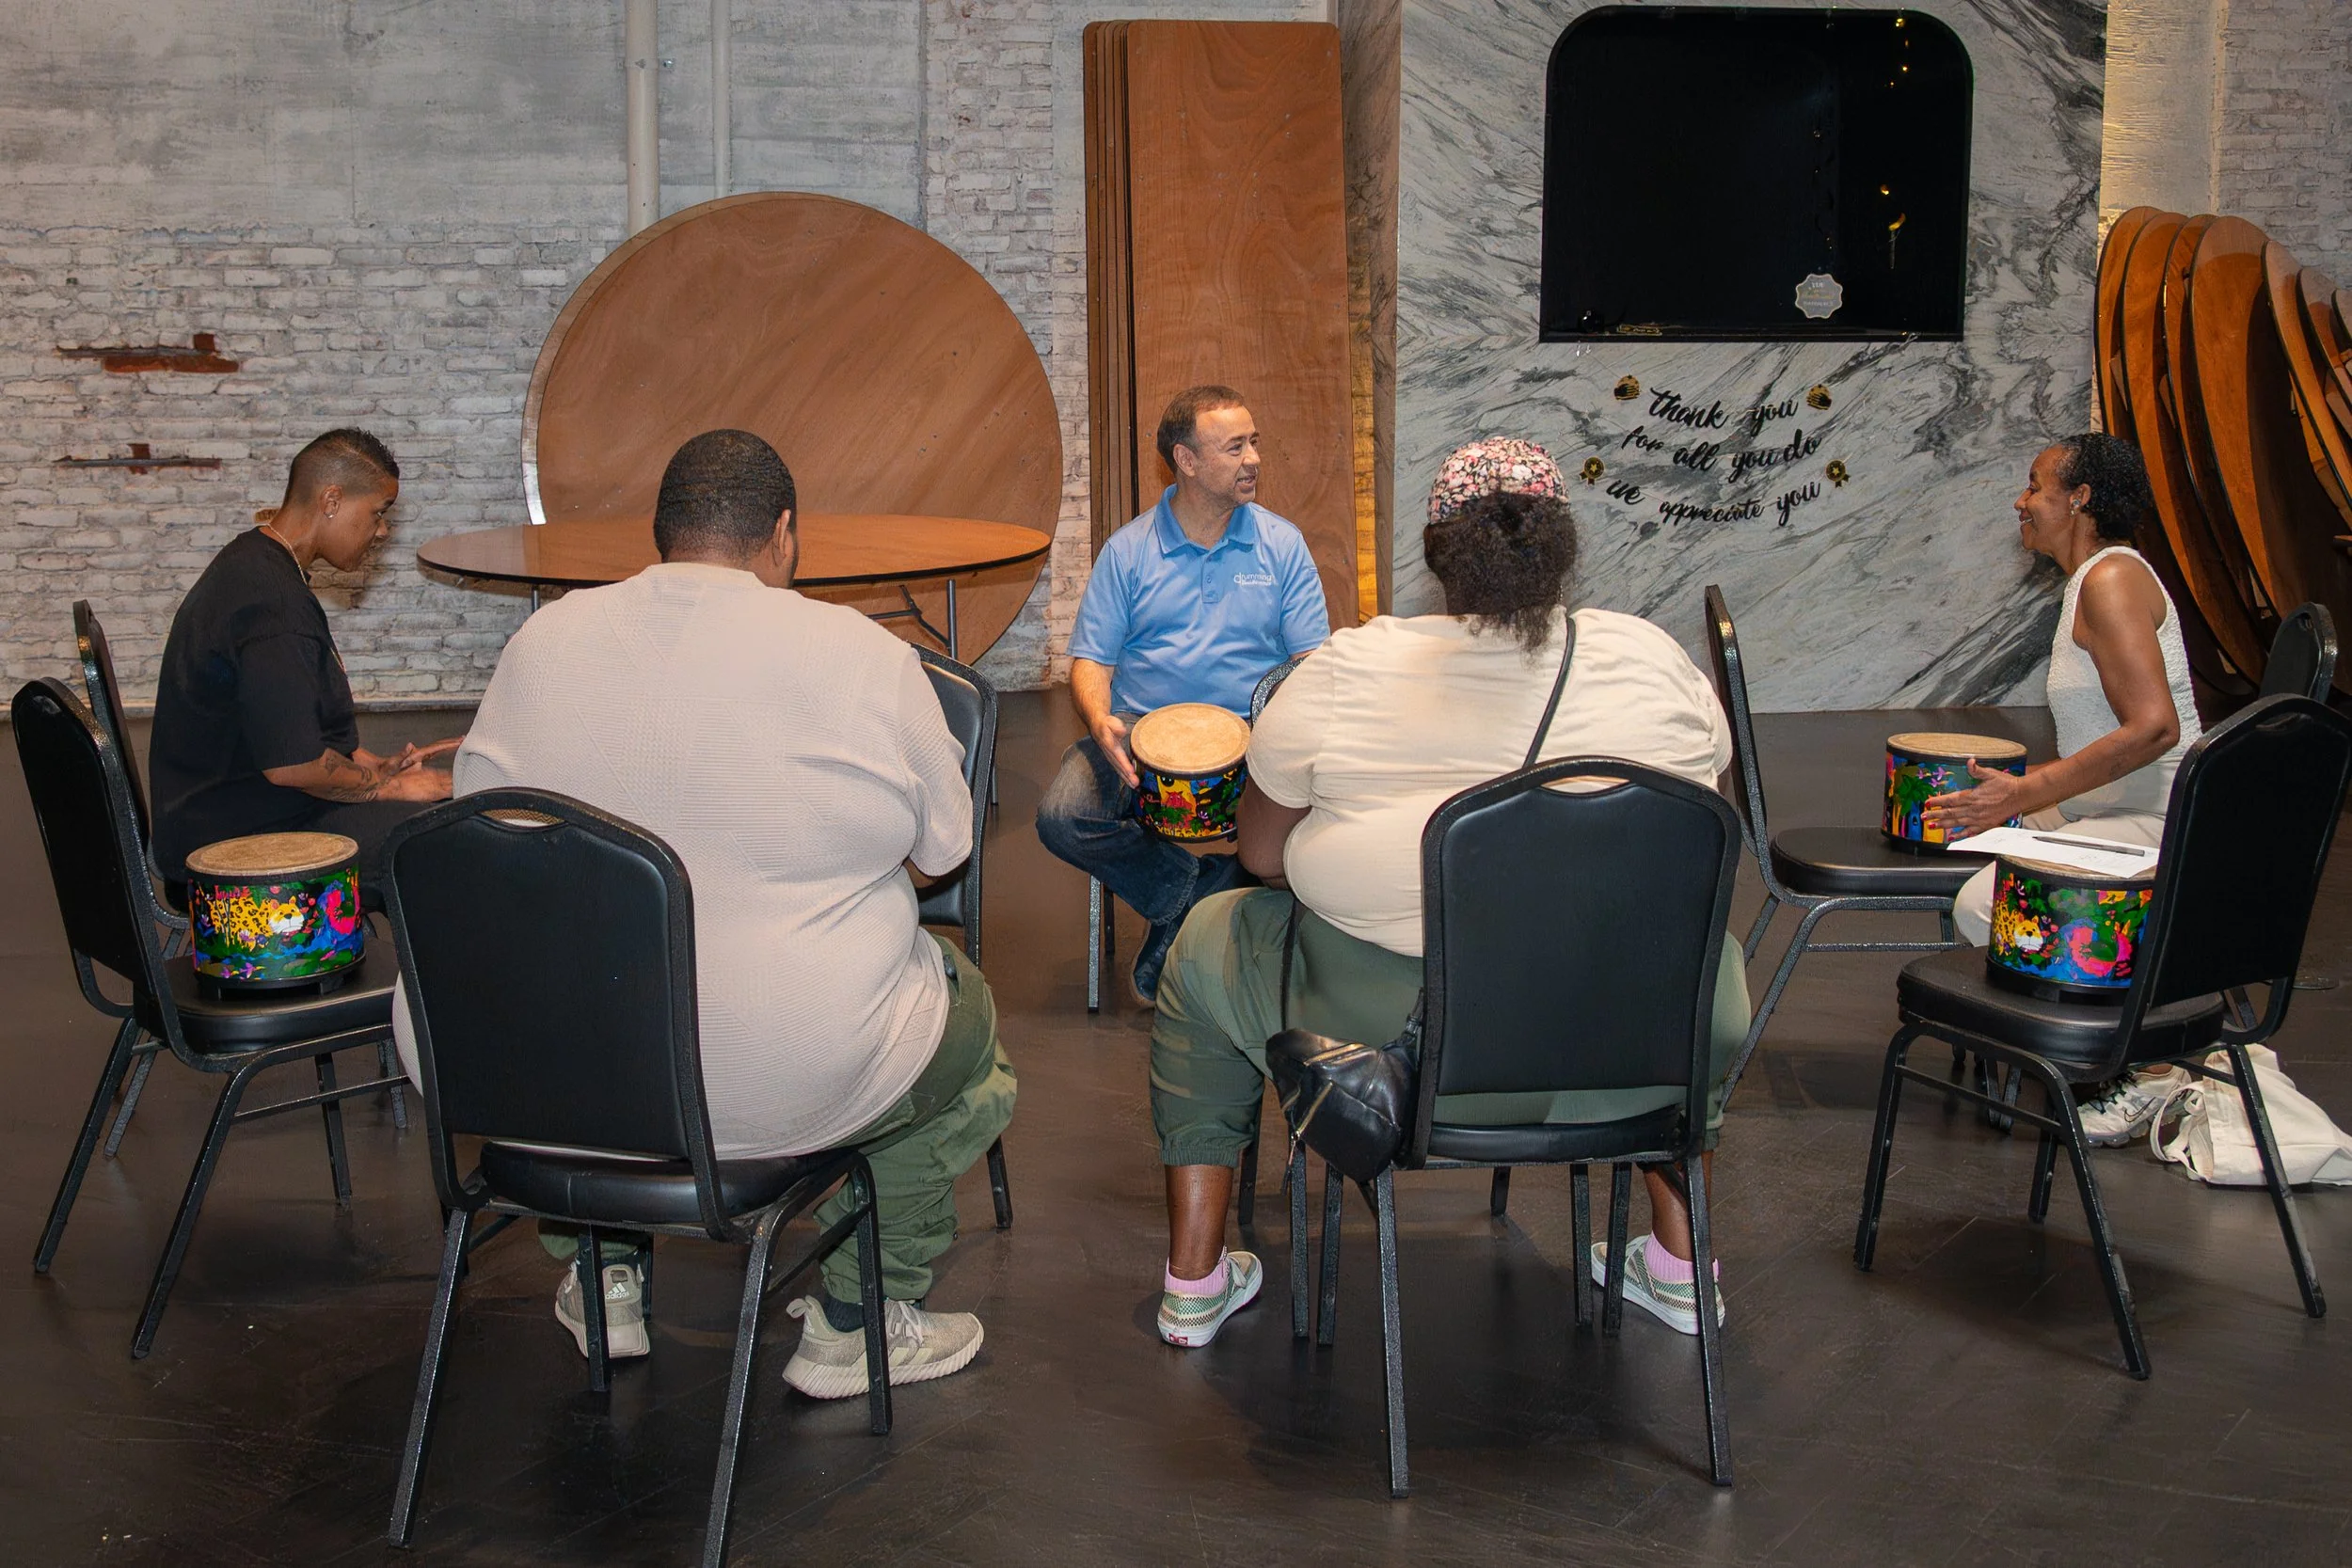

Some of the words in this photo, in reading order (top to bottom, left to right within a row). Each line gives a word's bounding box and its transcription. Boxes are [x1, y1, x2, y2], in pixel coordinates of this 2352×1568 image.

[1649, 388, 1729, 430] thank
[1751, 400, 1799, 436] you
[1621, 425, 1664, 451] for
[1673, 441, 1720, 471] all
[1728, 450, 1778, 483] you
[1784, 429, 1822, 462] do
[1606, 480, 1645, 505] we
[1659, 499, 1765, 526] appreciate
[1777, 482, 1821, 526] you
